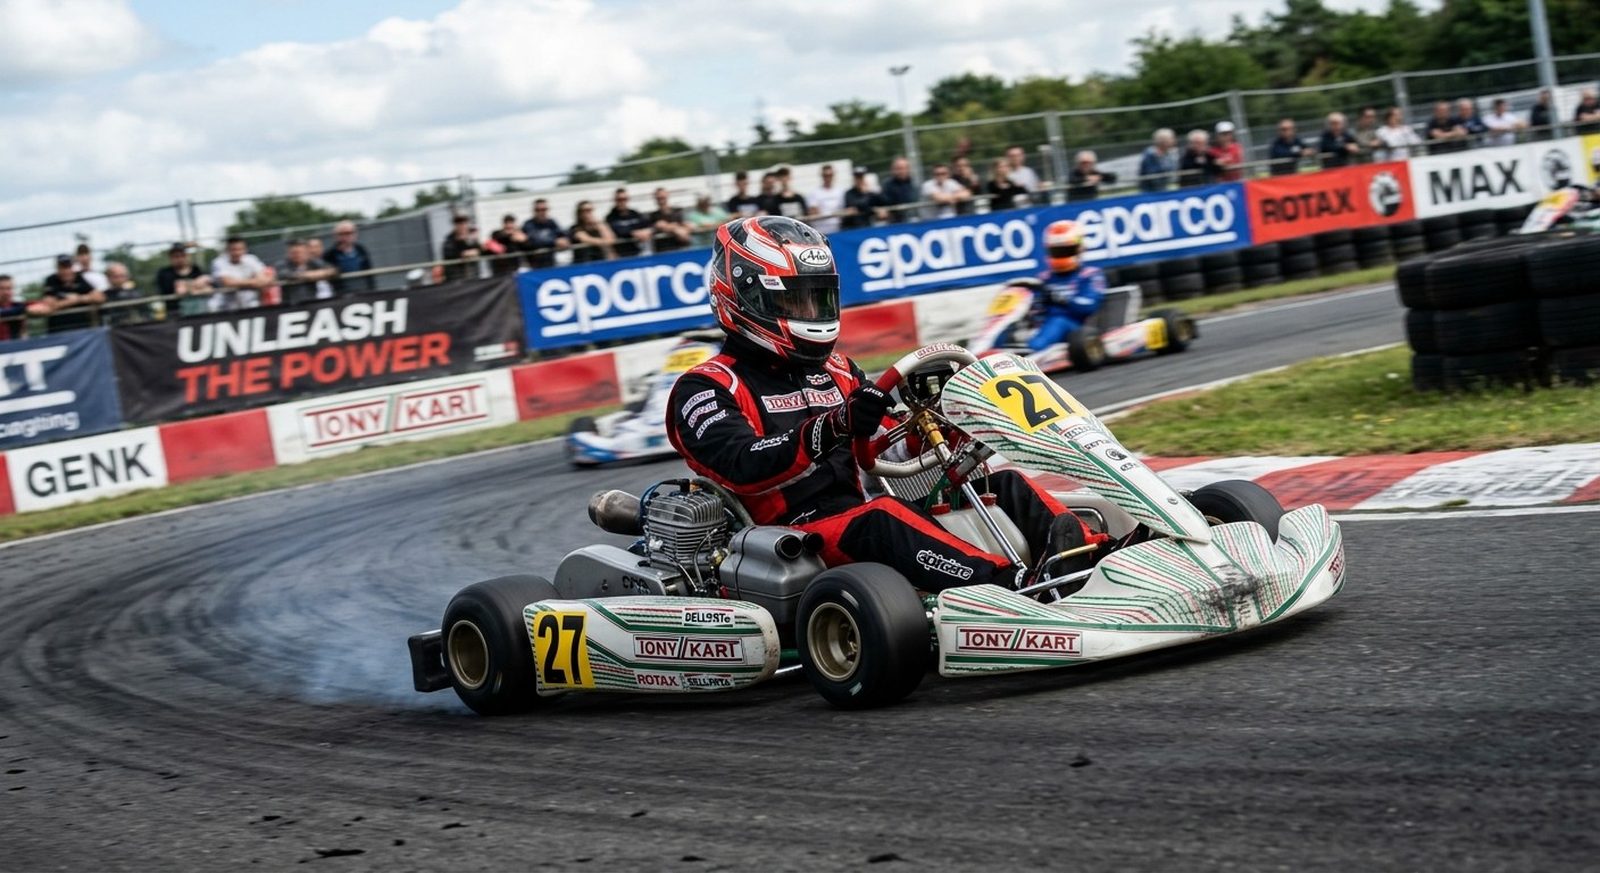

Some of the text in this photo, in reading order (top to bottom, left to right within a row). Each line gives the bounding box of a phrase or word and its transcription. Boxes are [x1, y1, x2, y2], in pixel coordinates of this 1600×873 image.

[1262, 187, 1355, 226] ROTAX
[1429, 159, 1525, 205] MAX
[857, 218, 1035, 289] sparco
[1076, 193, 1235, 259] sparco
[537, 261, 714, 334] sparc
[177, 298, 409, 364] UNLEASH
[175, 356, 272, 404] THE
[280, 331, 451, 390] POWER
[306, 386, 483, 442] TONY KART
[995, 374, 1075, 428] 27
[27, 443, 154, 497] GENK
[537, 614, 586, 685] 27
[689, 639, 738, 658] KART
[961, 629, 1078, 650] TONY KART
[637, 674, 678, 687] ROTAX
